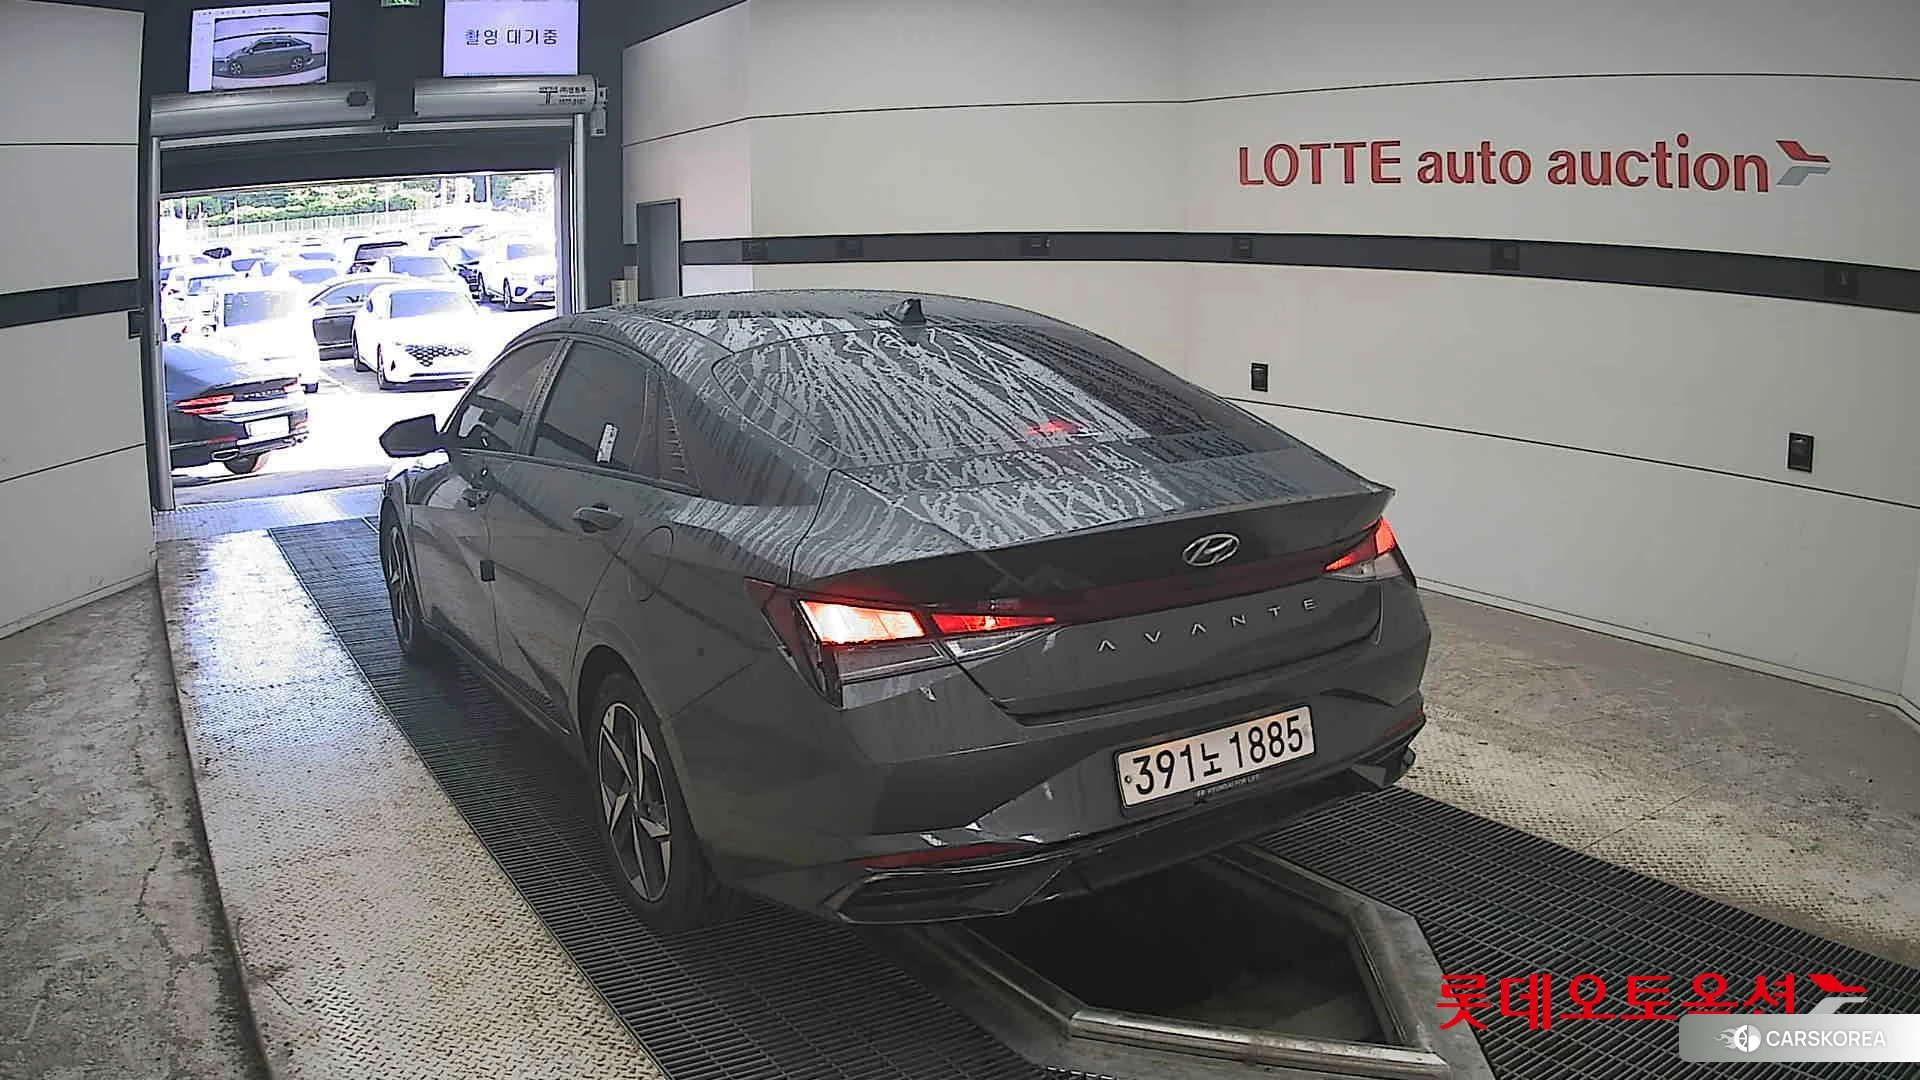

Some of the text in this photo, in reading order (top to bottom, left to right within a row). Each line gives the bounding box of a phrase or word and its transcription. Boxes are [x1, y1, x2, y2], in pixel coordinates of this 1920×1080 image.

[506, 28, 558, 46] 대기중
[1239, 132, 1769, 193] LOTTE auto auction
[1098, 598, 1318, 652] AVANTE
